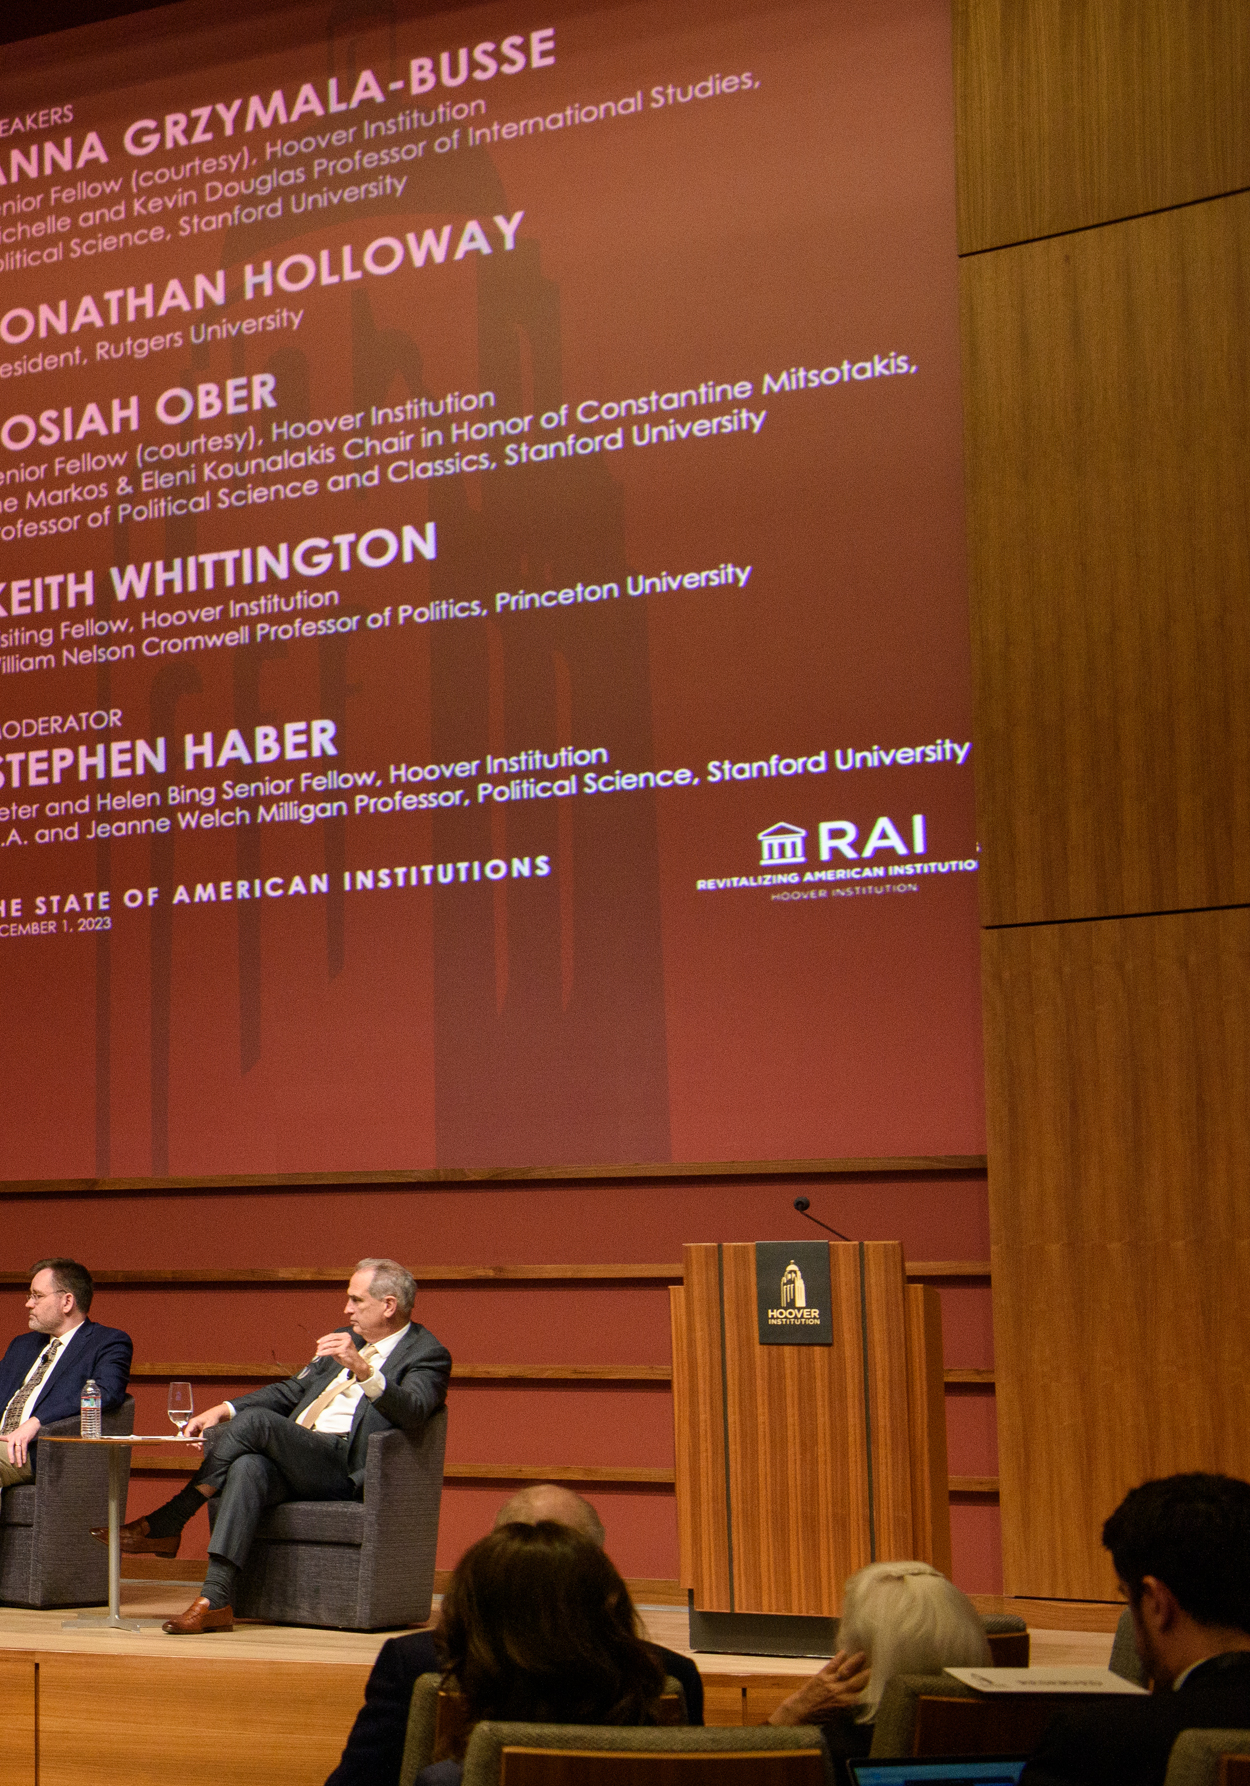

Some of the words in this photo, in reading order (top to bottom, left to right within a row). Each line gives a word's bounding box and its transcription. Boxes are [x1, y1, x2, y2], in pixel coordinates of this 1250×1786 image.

[123, 28, 555, 156] GRZYMALA-BUSSE
[50, 179, 122, 205] Fellow
[131, 148, 256, 192] (courtesy),
[265, 128, 355, 160] Hoover
[364, 100, 486, 139] Institution
[78, 202, 125, 227] and
[133, 189, 197, 215] Kevin
[205, 168, 305, 201] Douglas
[313, 141, 426, 178] Professor
[433, 129, 459, 153] of
[468, 91, 642, 146] International
[650, 72, 761, 108] Studies,
[69, 226, 171, 258] Science,
[179, 198, 282, 236] Stanford
[291, 175, 407, 213] University
[244, 211, 524, 299] HOLLOWAY
[95, 332, 183, 360] Rutgers
[190, 309, 304, 344] University
[25, 483, 108, 508] Markos
[116, 477, 133, 495] &
[141, 470, 195, 491] Eleni
[203, 444, 335, 480] Kounalakis
[343, 431, 414, 459] Chair
[421, 428, 443, 447] in
[451, 415, 533, 442] Honor
[540, 404, 568, 429] of
[576, 381, 753, 423] Constantine
[762, 352, 918, 394] Mitsotakis,
[54, 453, 127, 475] Fellow
[136, 427, 263, 468] (courtesy),
[272, 412, 364, 441] Hoover
[371, 391, 495, 425] Institution
[155, 373, 277, 424] OBER
[86, 506, 110, 528] of
[118, 492, 210, 523] Political
[217, 480, 319, 509] Science
[326, 466, 380, 492] and
[387, 453, 497, 483] Classics,
[505, 428, 624, 466] Stanford
[632, 409, 767, 446] University
[109, 522, 437, 601] WHITTINGTON
[60, 620, 133, 639] Fellow,
[141, 606, 223, 629] Hoover
[229, 591, 339, 617] Institution
[62, 644, 135, 666] Nelson
[141, 626, 250, 657] Cromwell
[256, 616, 360, 642] Professor
[366, 607, 392, 629] of
[398, 599, 488, 625] Politics,
[495, 583, 620, 612] Princeton
[626, 564, 752, 597] University
[45, 797, 90, 817] and
[97, 793, 161, 811] Helen
[168, 787, 216, 806] Bing
[222, 780, 292, 800] Senior
[301, 771, 382, 791] Fellow,
[389, 760, 481, 783] Hoover
[486, 746, 609, 774] Institution
[184, 719, 338, 770] HABER
[34, 823, 79, 844] and
[86, 818, 171, 839] Jeanne
[177, 808, 251, 829] Welch
[257, 801, 348, 824] Milligan
[354, 790, 470, 814] Professor,
[477, 775, 578, 803] Political
[583, 769, 700, 794] Science,
[707, 751, 828, 783] Stanford
[835, 739, 972, 771] University
[818, 814, 926, 861] RAI
[35, 891, 110, 915] STATE
[123, 887, 158, 908] OF
[172, 874, 329, 904] AMERICAN
[344, 855, 551, 891] INSTITUTIONS
[696, 873, 800, 892] REVITALIZING
[802, 867, 885, 884] AMERICAN
[771, 889, 828, 902] HOOVER
[832, 883, 918, 898] INSTITUTION
[63, 920, 74, 933] 1,
[78, 917, 113, 932] 2023
[768, 1308, 820, 1319] HOOVER
